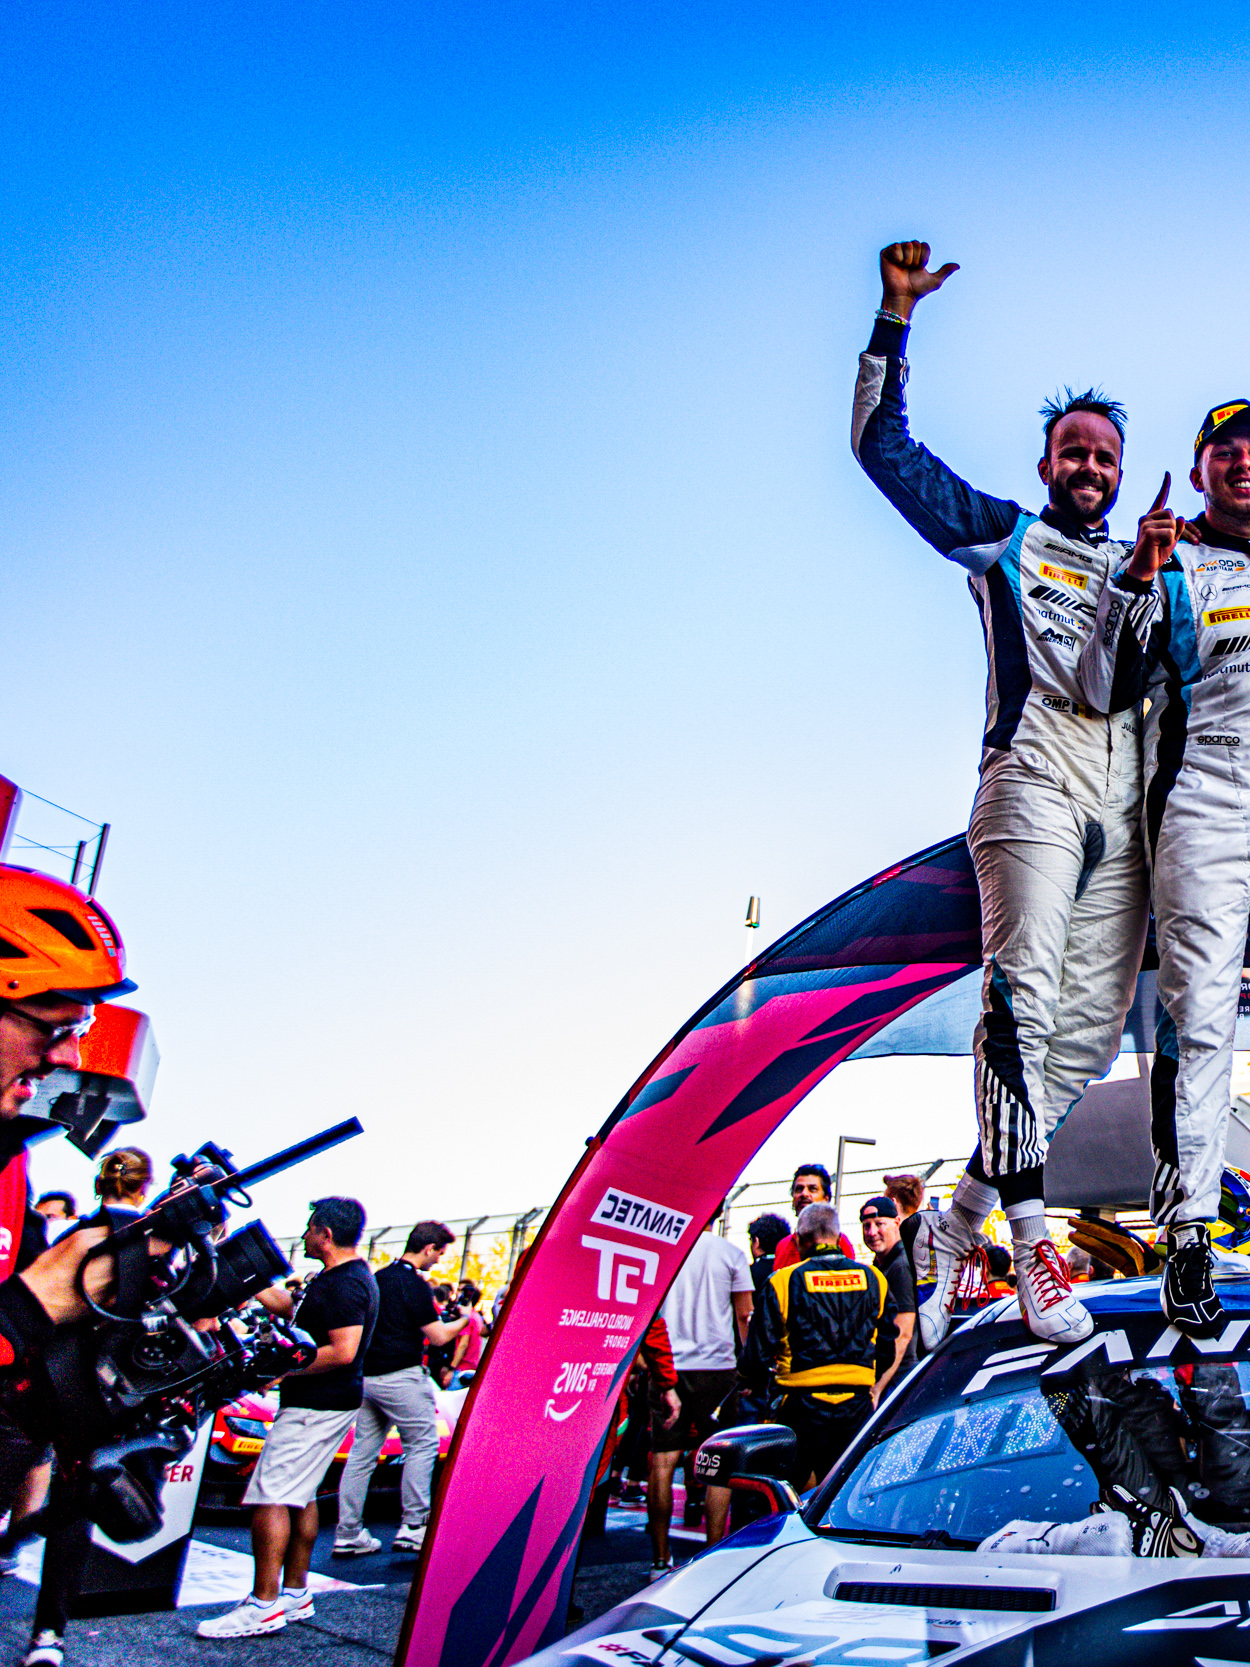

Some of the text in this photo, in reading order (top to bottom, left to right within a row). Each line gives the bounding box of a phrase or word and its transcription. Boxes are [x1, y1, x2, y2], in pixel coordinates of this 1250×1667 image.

[1061, 547, 1093, 563] AMG
[1043, 565, 1085, 587] PIRELLI
[1102, 600, 1122, 648] sparco
[1042, 697, 1070, 709] OMP
[1197, 735, 1240, 747] sparco
[812, 1274, 861, 1286] PIRELLI
